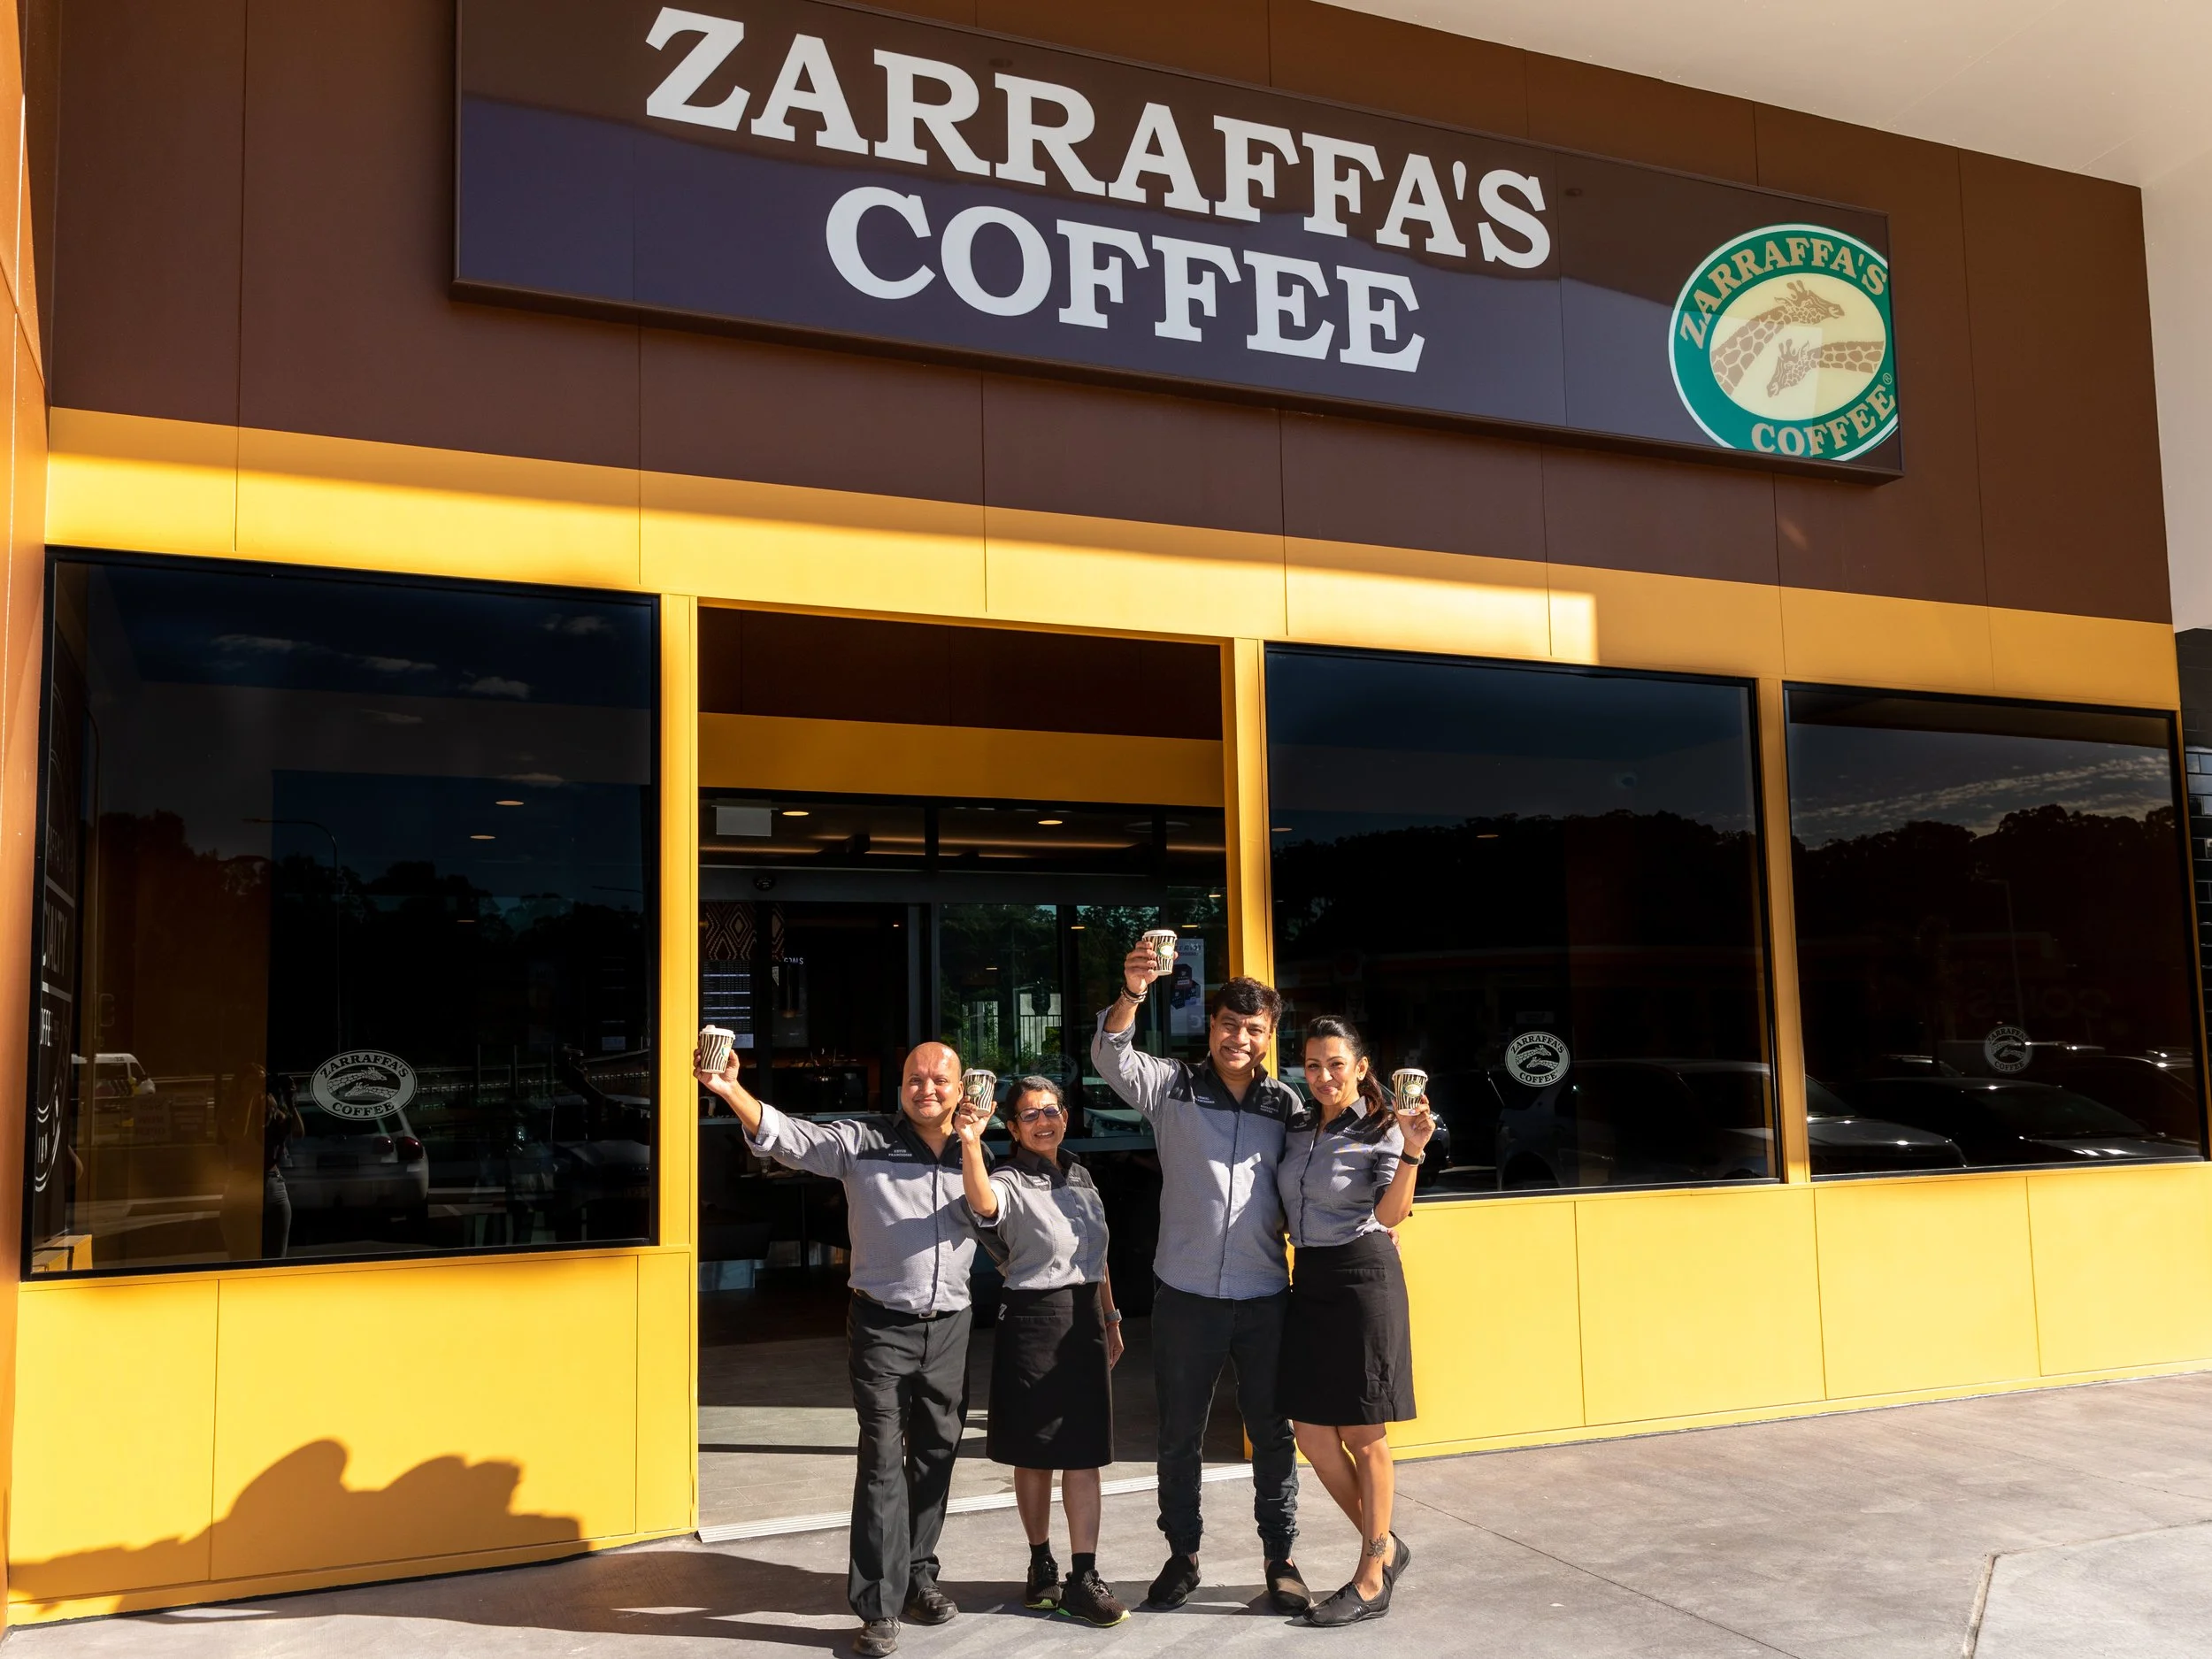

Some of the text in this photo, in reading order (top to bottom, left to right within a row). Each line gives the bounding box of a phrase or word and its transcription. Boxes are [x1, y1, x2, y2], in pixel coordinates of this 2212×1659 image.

[646, 6, 1551, 269] ZARRAFFA'S
[826, 186, 1425, 373] COFFEE
[1679, 237, 1888, 349] ZARRAFFA'S
[1510, 1035, 1564, 1054] ZARRAFFA'S
[320, 1054, 410, 1079] ZARRAFFA'S
[1519, 1071, 1557, 1083] COFFEE
[1994, 1061, 2024, 1071] COFFEE
[332, 1102, 395, 1116] COFFEE
